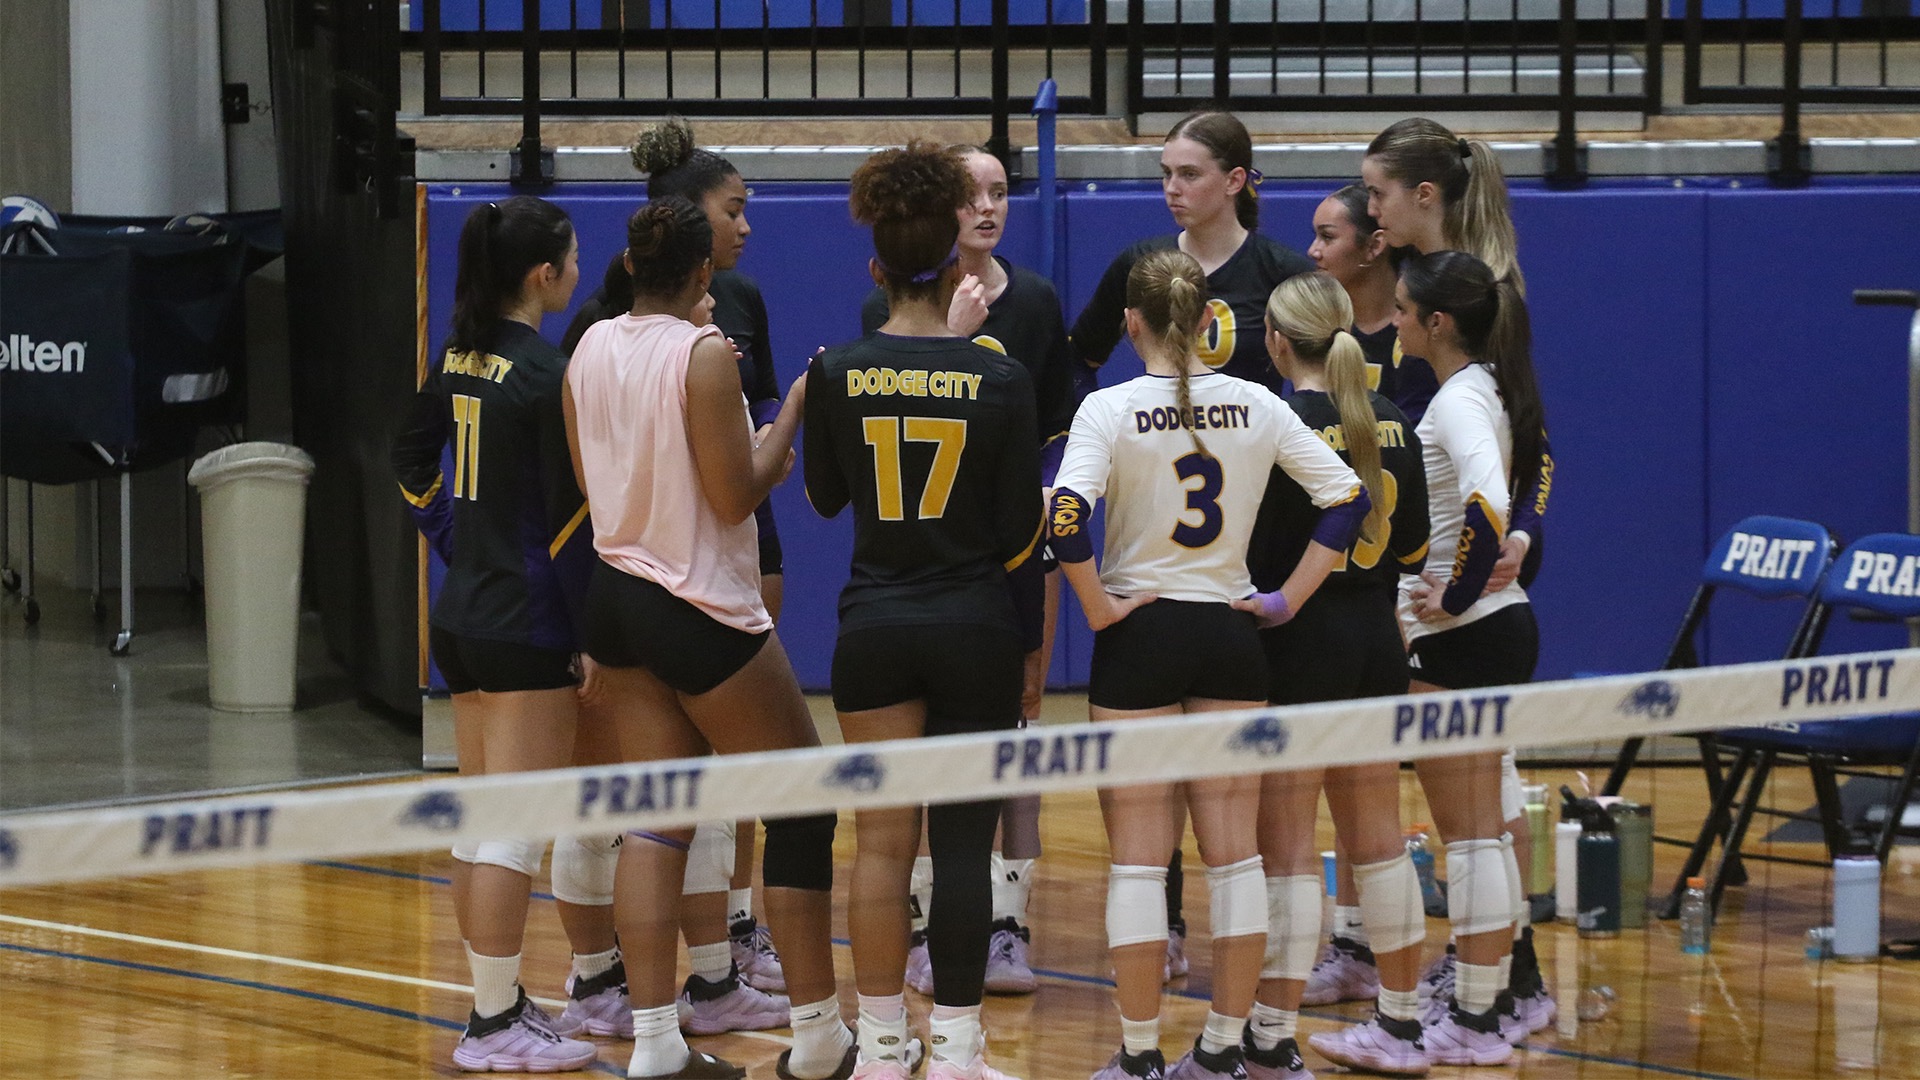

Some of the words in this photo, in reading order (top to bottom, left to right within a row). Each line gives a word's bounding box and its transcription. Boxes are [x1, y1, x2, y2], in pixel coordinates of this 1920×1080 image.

[847, 367, 928, 397] DODGE
[928, 371, 983, 400] CITY
[1207, 404, 1250, 430] CITY
[1377, 420, 1406, 448] ITY
[451, 394, 481, 501] 11
[862, 416, 968, 521] 17
[1169, 450, 1225, 550] 3
[1721, 532, 1816, 580] PRATT
[1844, 550, 1920, 597] PRA
[1780, 659, 1895, 708] PRATT
[1393, 695, 1512, 745] PRATT
[993, 730, 1114, 780] PRATT
[576, 767, 706, 819] PRATT
[140, 804, 274, 857] PRATT
